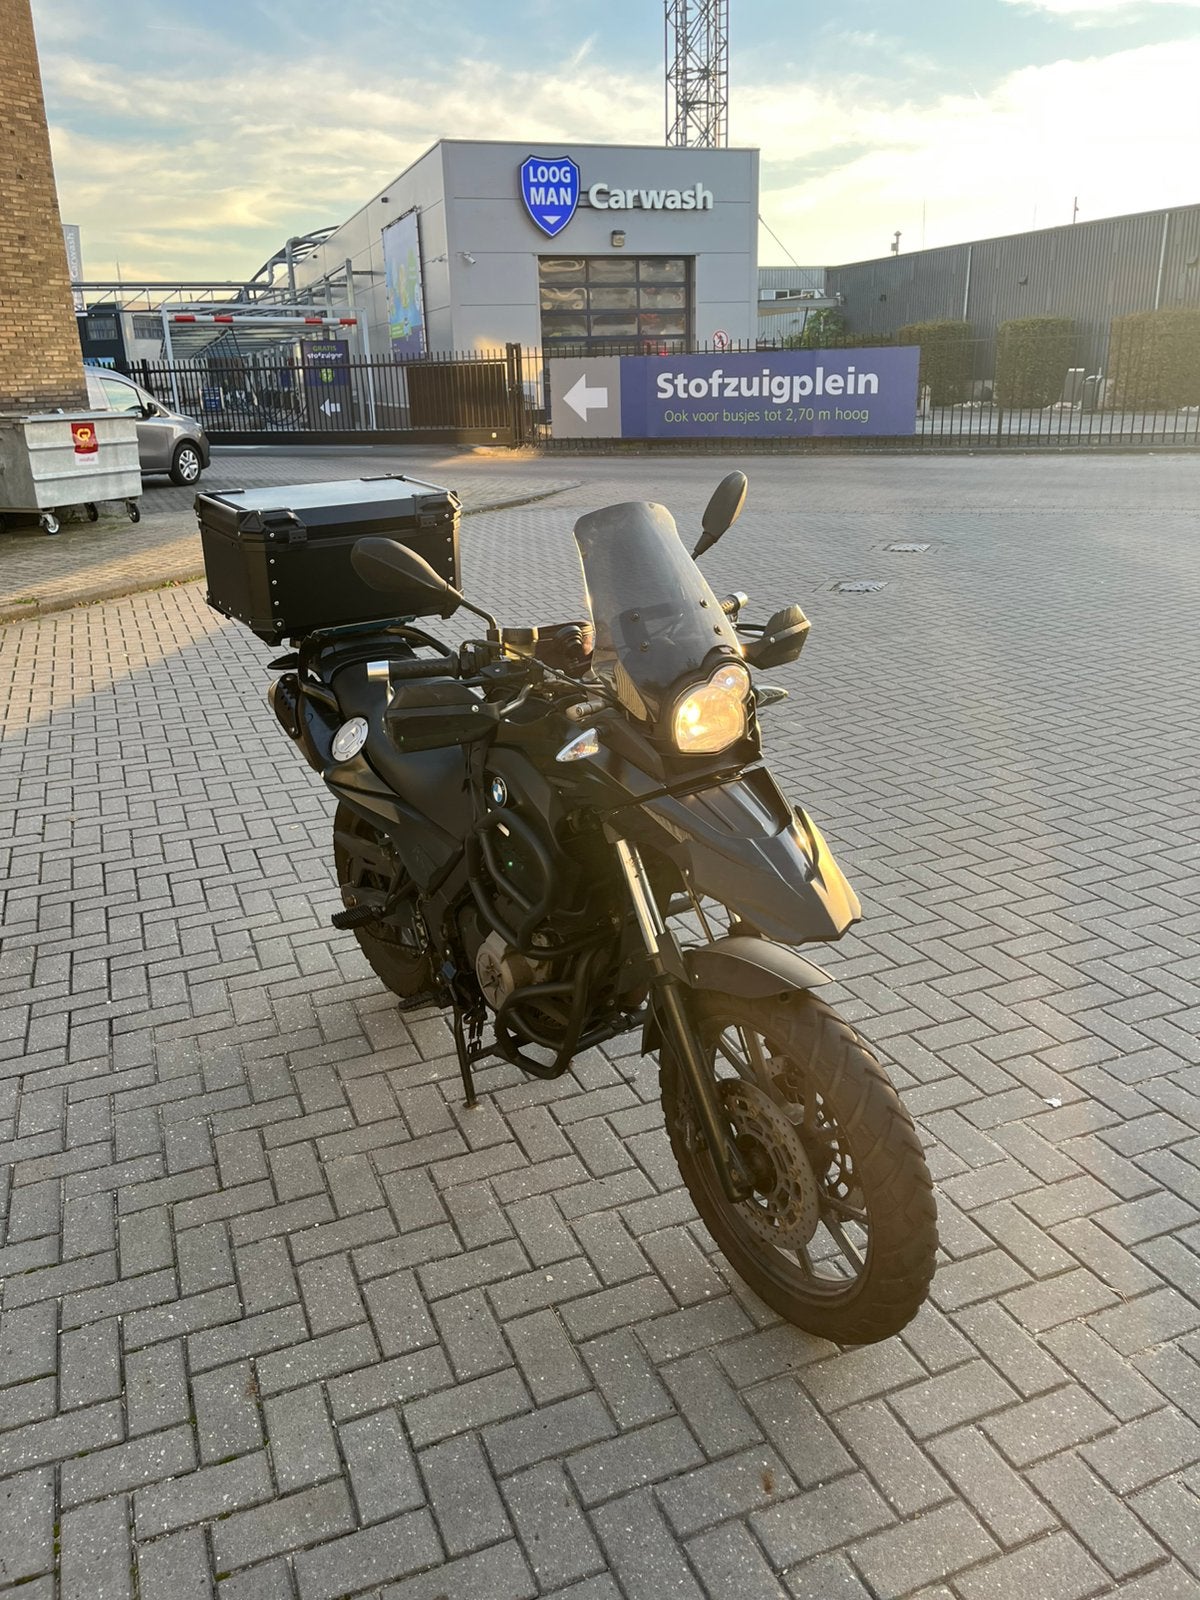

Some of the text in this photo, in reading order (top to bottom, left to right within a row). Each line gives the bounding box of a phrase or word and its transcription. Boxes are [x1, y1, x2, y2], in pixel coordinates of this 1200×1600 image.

[529, 166, 571, 183] LOOG
[530, 187, 572, 206] MAN
[588, 182, 714, 210] Carwash
[656, 366, 879, 404] Stofzuigplein
[664, 407, 870, 425] Ook voor busjes tot 2,70 m hoog
